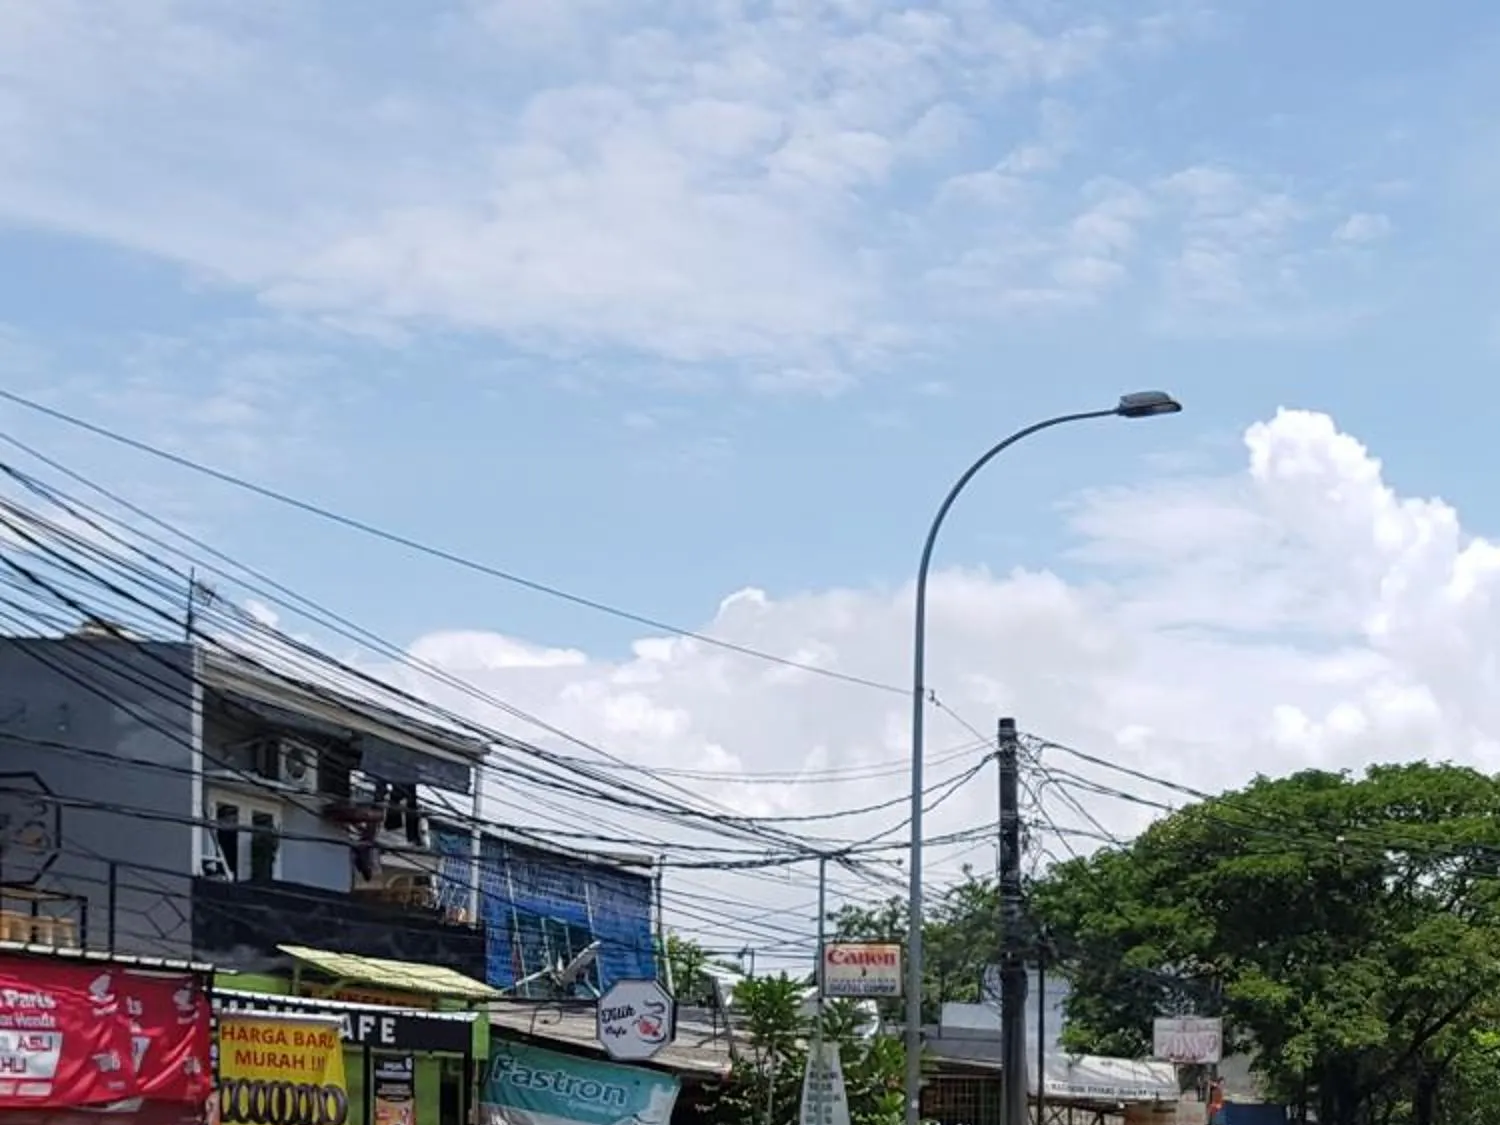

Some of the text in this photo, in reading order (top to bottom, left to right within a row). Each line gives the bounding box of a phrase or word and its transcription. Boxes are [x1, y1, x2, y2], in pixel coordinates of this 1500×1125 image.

[828, 948, 897, 966] Canon
[221, 1025, 289, 1046] HARGA
[321, 1011, 396, 1044] AFE
[235, 1050, 305, 1070] MURAH
[492, 1054, 627, 1106] Fastron
